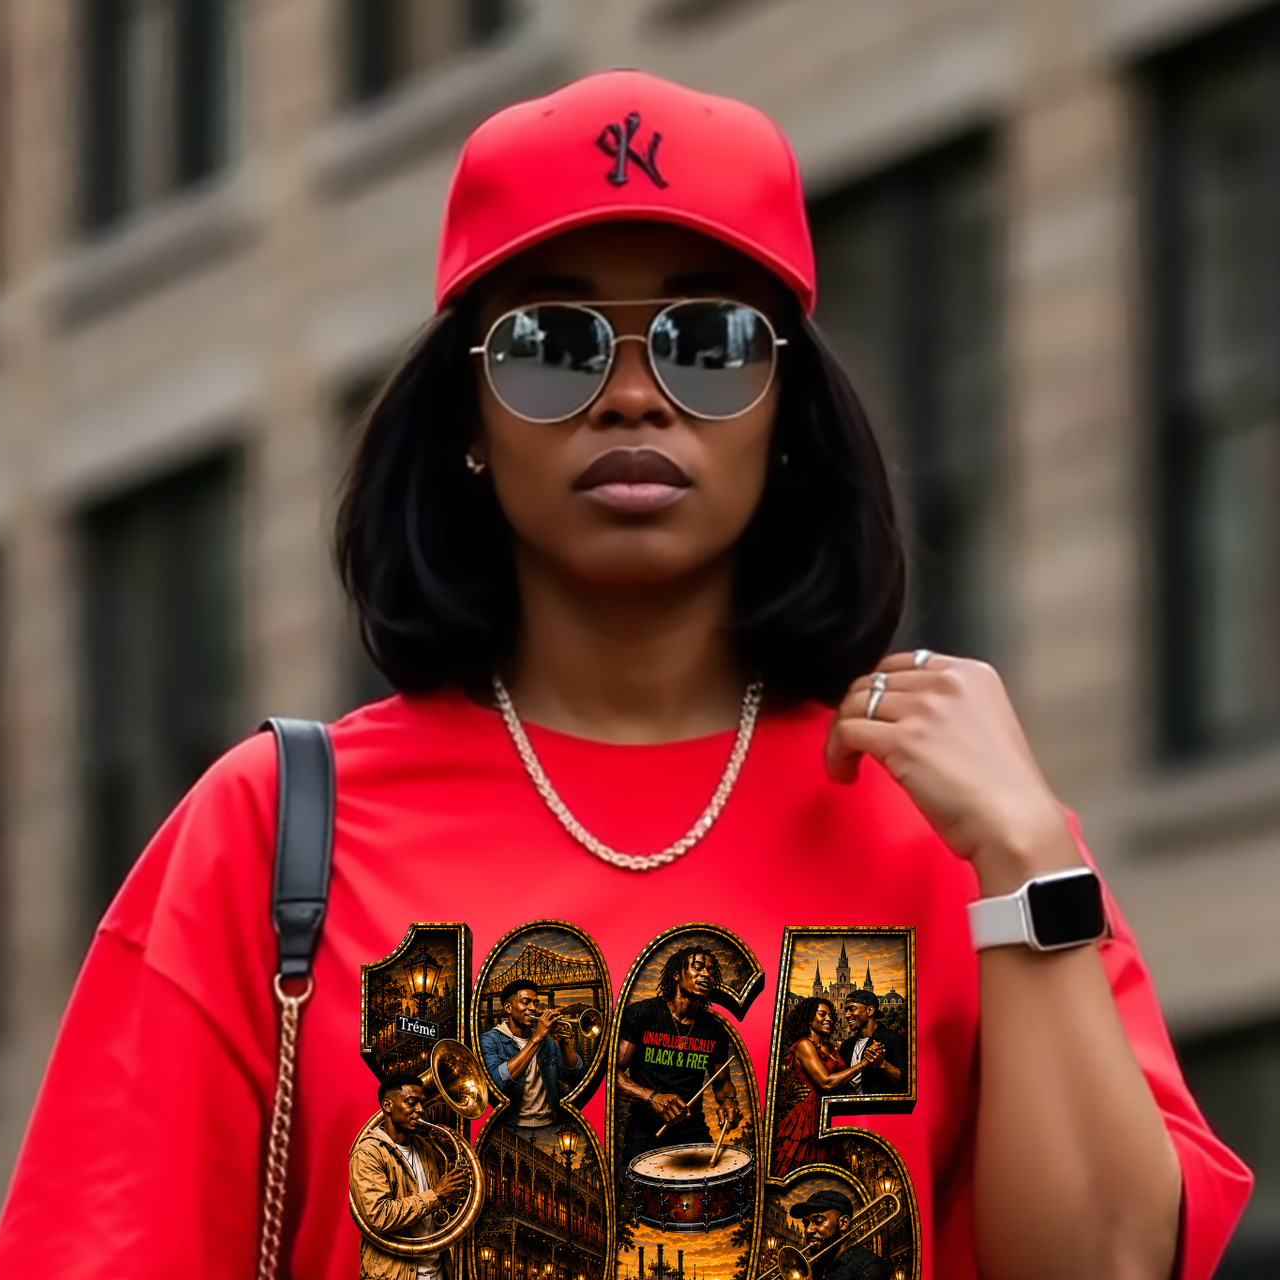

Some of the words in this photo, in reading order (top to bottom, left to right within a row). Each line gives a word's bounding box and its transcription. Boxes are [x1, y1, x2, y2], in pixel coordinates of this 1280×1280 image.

[399, 1016, 436, 1037] Trémé
[644, 1046, 675, 1066] BLACK
[675, 1051, 684, 1067] &
[685, 1052, 710, 1070] FREE
